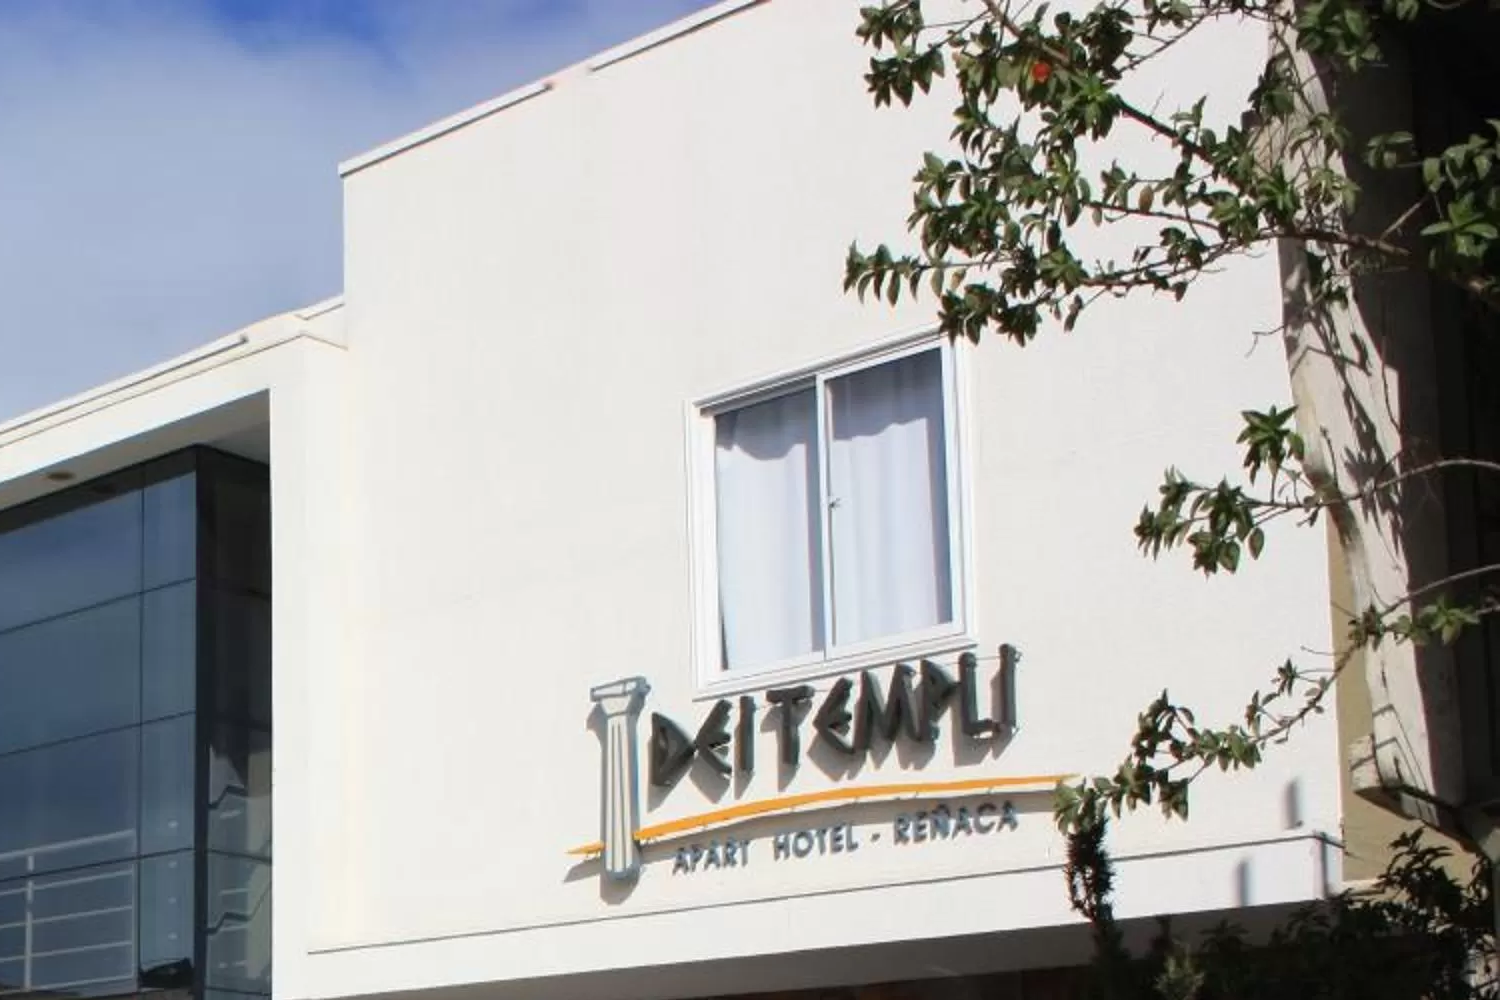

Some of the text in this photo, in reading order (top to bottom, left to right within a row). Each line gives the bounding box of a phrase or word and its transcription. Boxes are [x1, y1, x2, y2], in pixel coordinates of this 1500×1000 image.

[650, 643, 1019, 787] DEI TEMPLI
[672, 838, 751, 876] APART
[772, 822, 859, 862] HOTEL
[893, 801, 1019, 845] REÑACA
